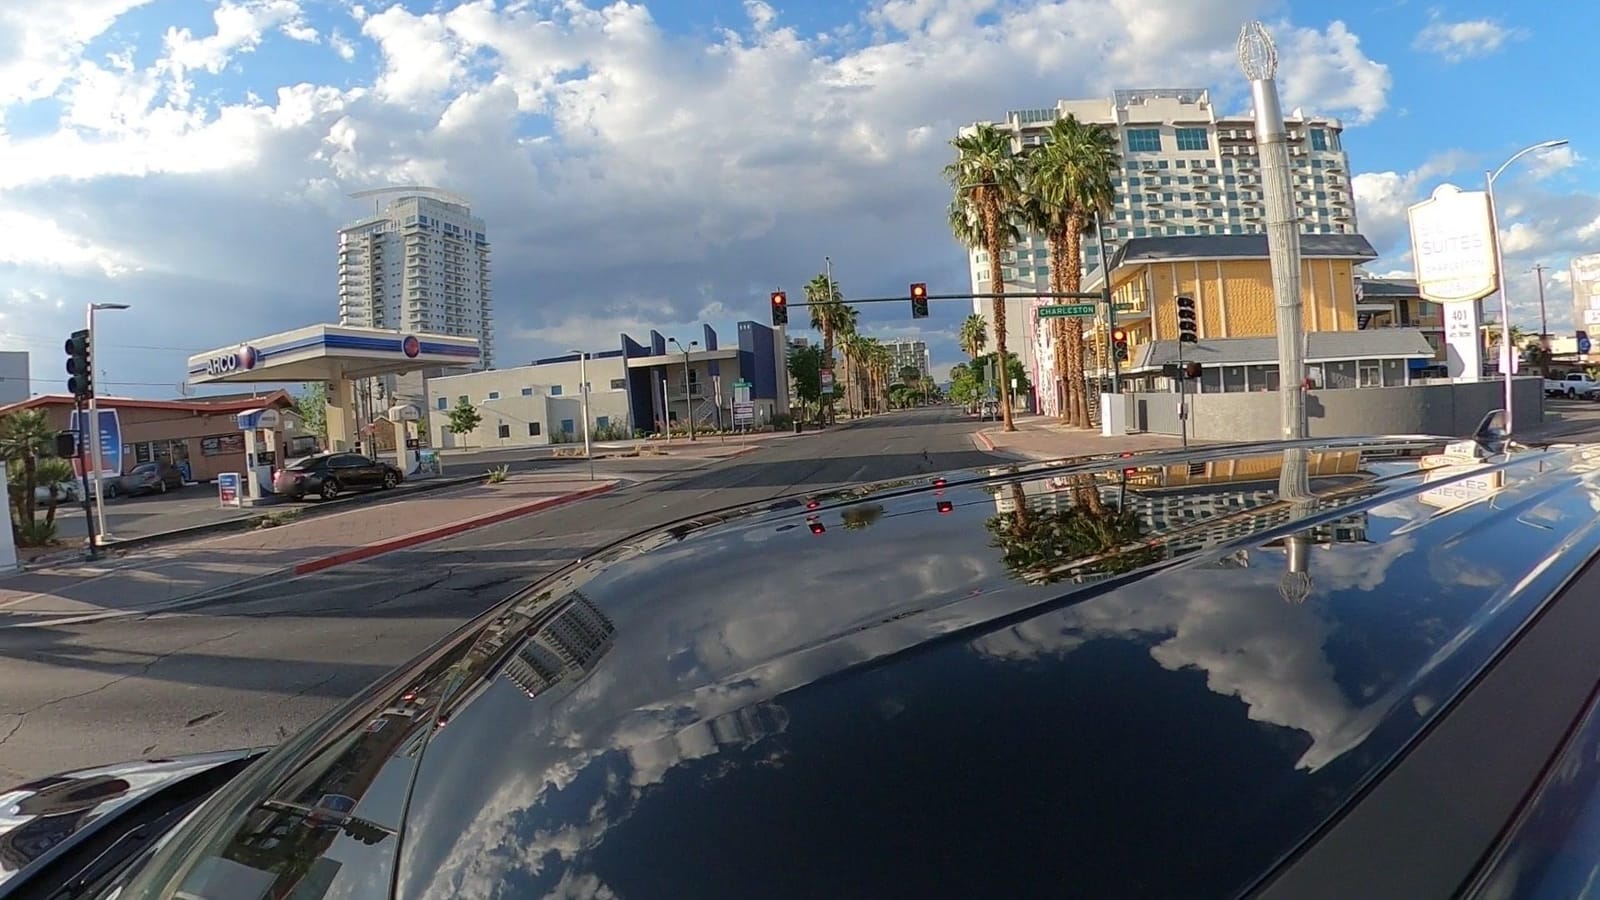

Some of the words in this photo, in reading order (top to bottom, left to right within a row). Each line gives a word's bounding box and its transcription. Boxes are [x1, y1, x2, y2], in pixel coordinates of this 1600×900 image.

[1422, 233, 1483, 256] SUITES
[1039, 306, 1094, 316] CHARLESTON
[1452, 309, 1467, 321] 401
[207, 354, 236, 375] ARCO
